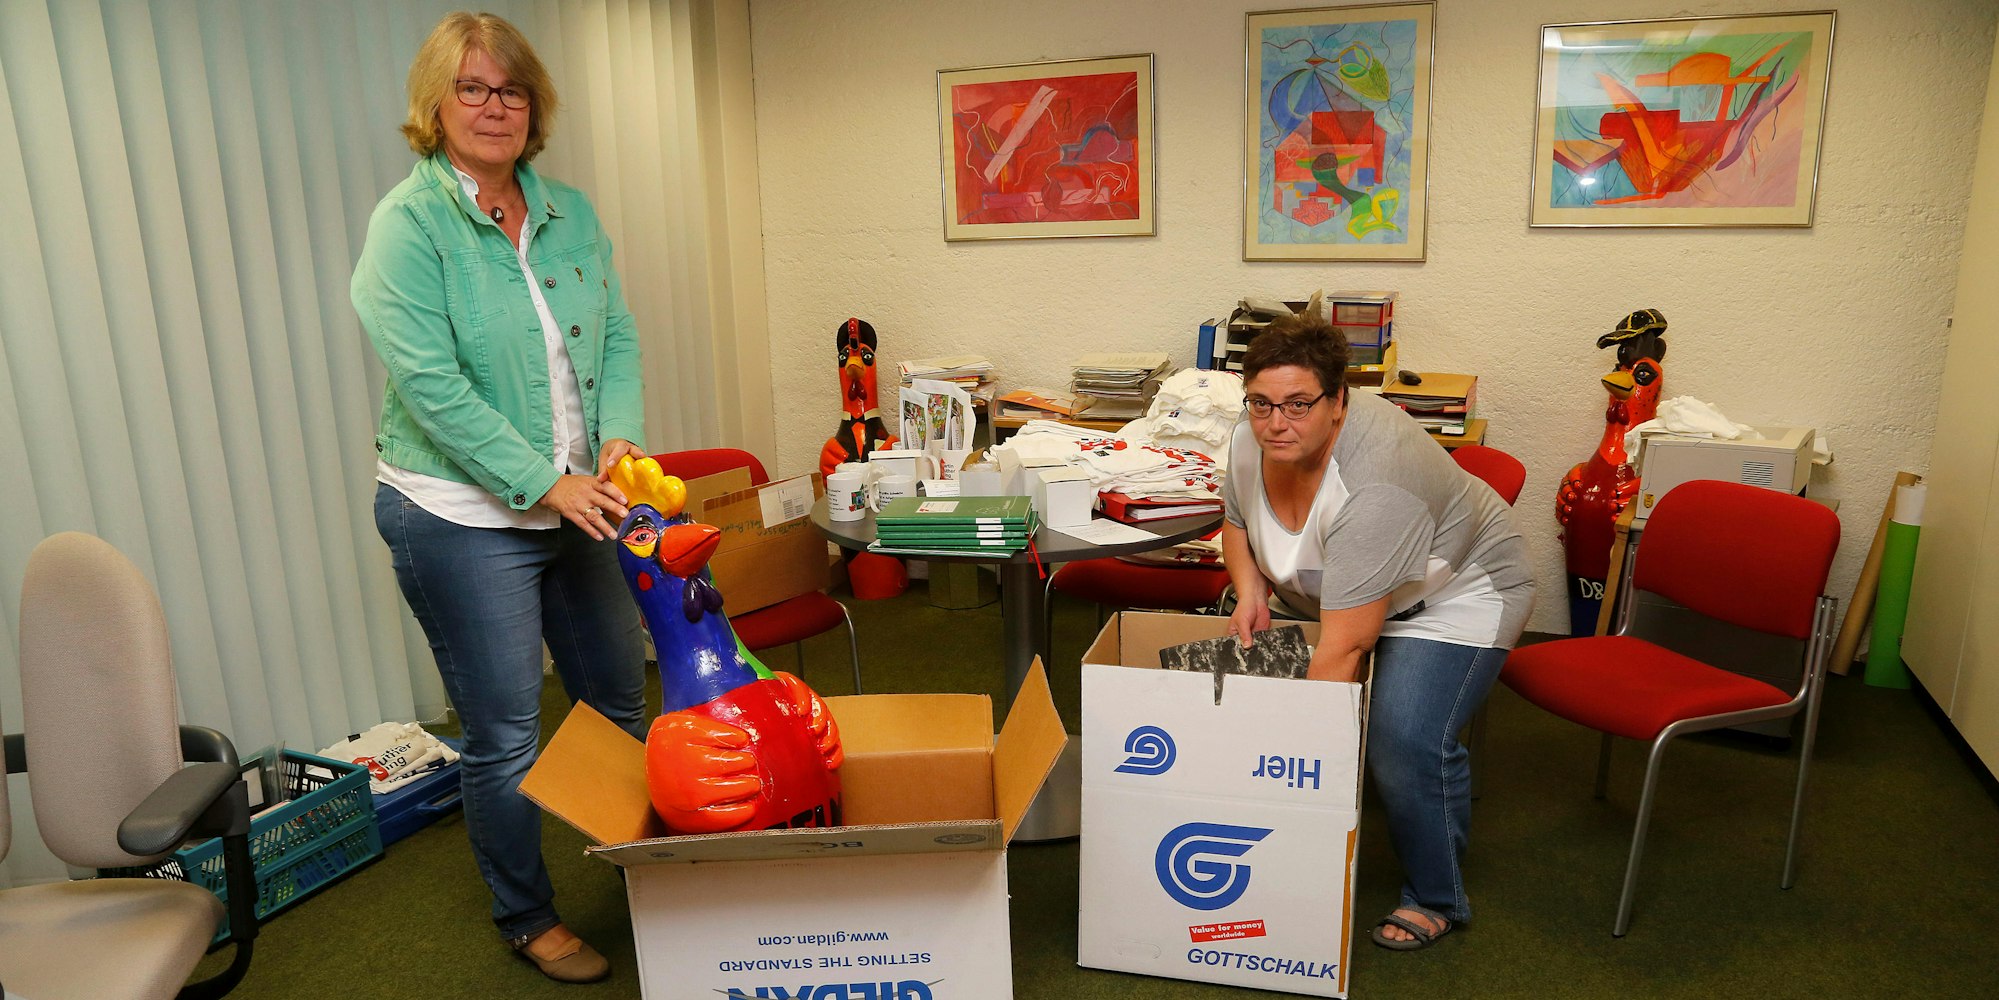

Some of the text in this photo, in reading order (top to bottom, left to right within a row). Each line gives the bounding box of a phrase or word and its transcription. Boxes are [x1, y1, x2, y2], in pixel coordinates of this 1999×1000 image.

[1252, 755, 1321, 790] Hier
[1191, 922, 1262, 934] Value for money
[1211, 931, 1246, 939] worldwide
[758, 931, 889, 945] www.gildan.com
[719, 952, 931, 971] SETTING THE STANDARD
[1187, 948, 1338, 979] GOTTSCHALK
